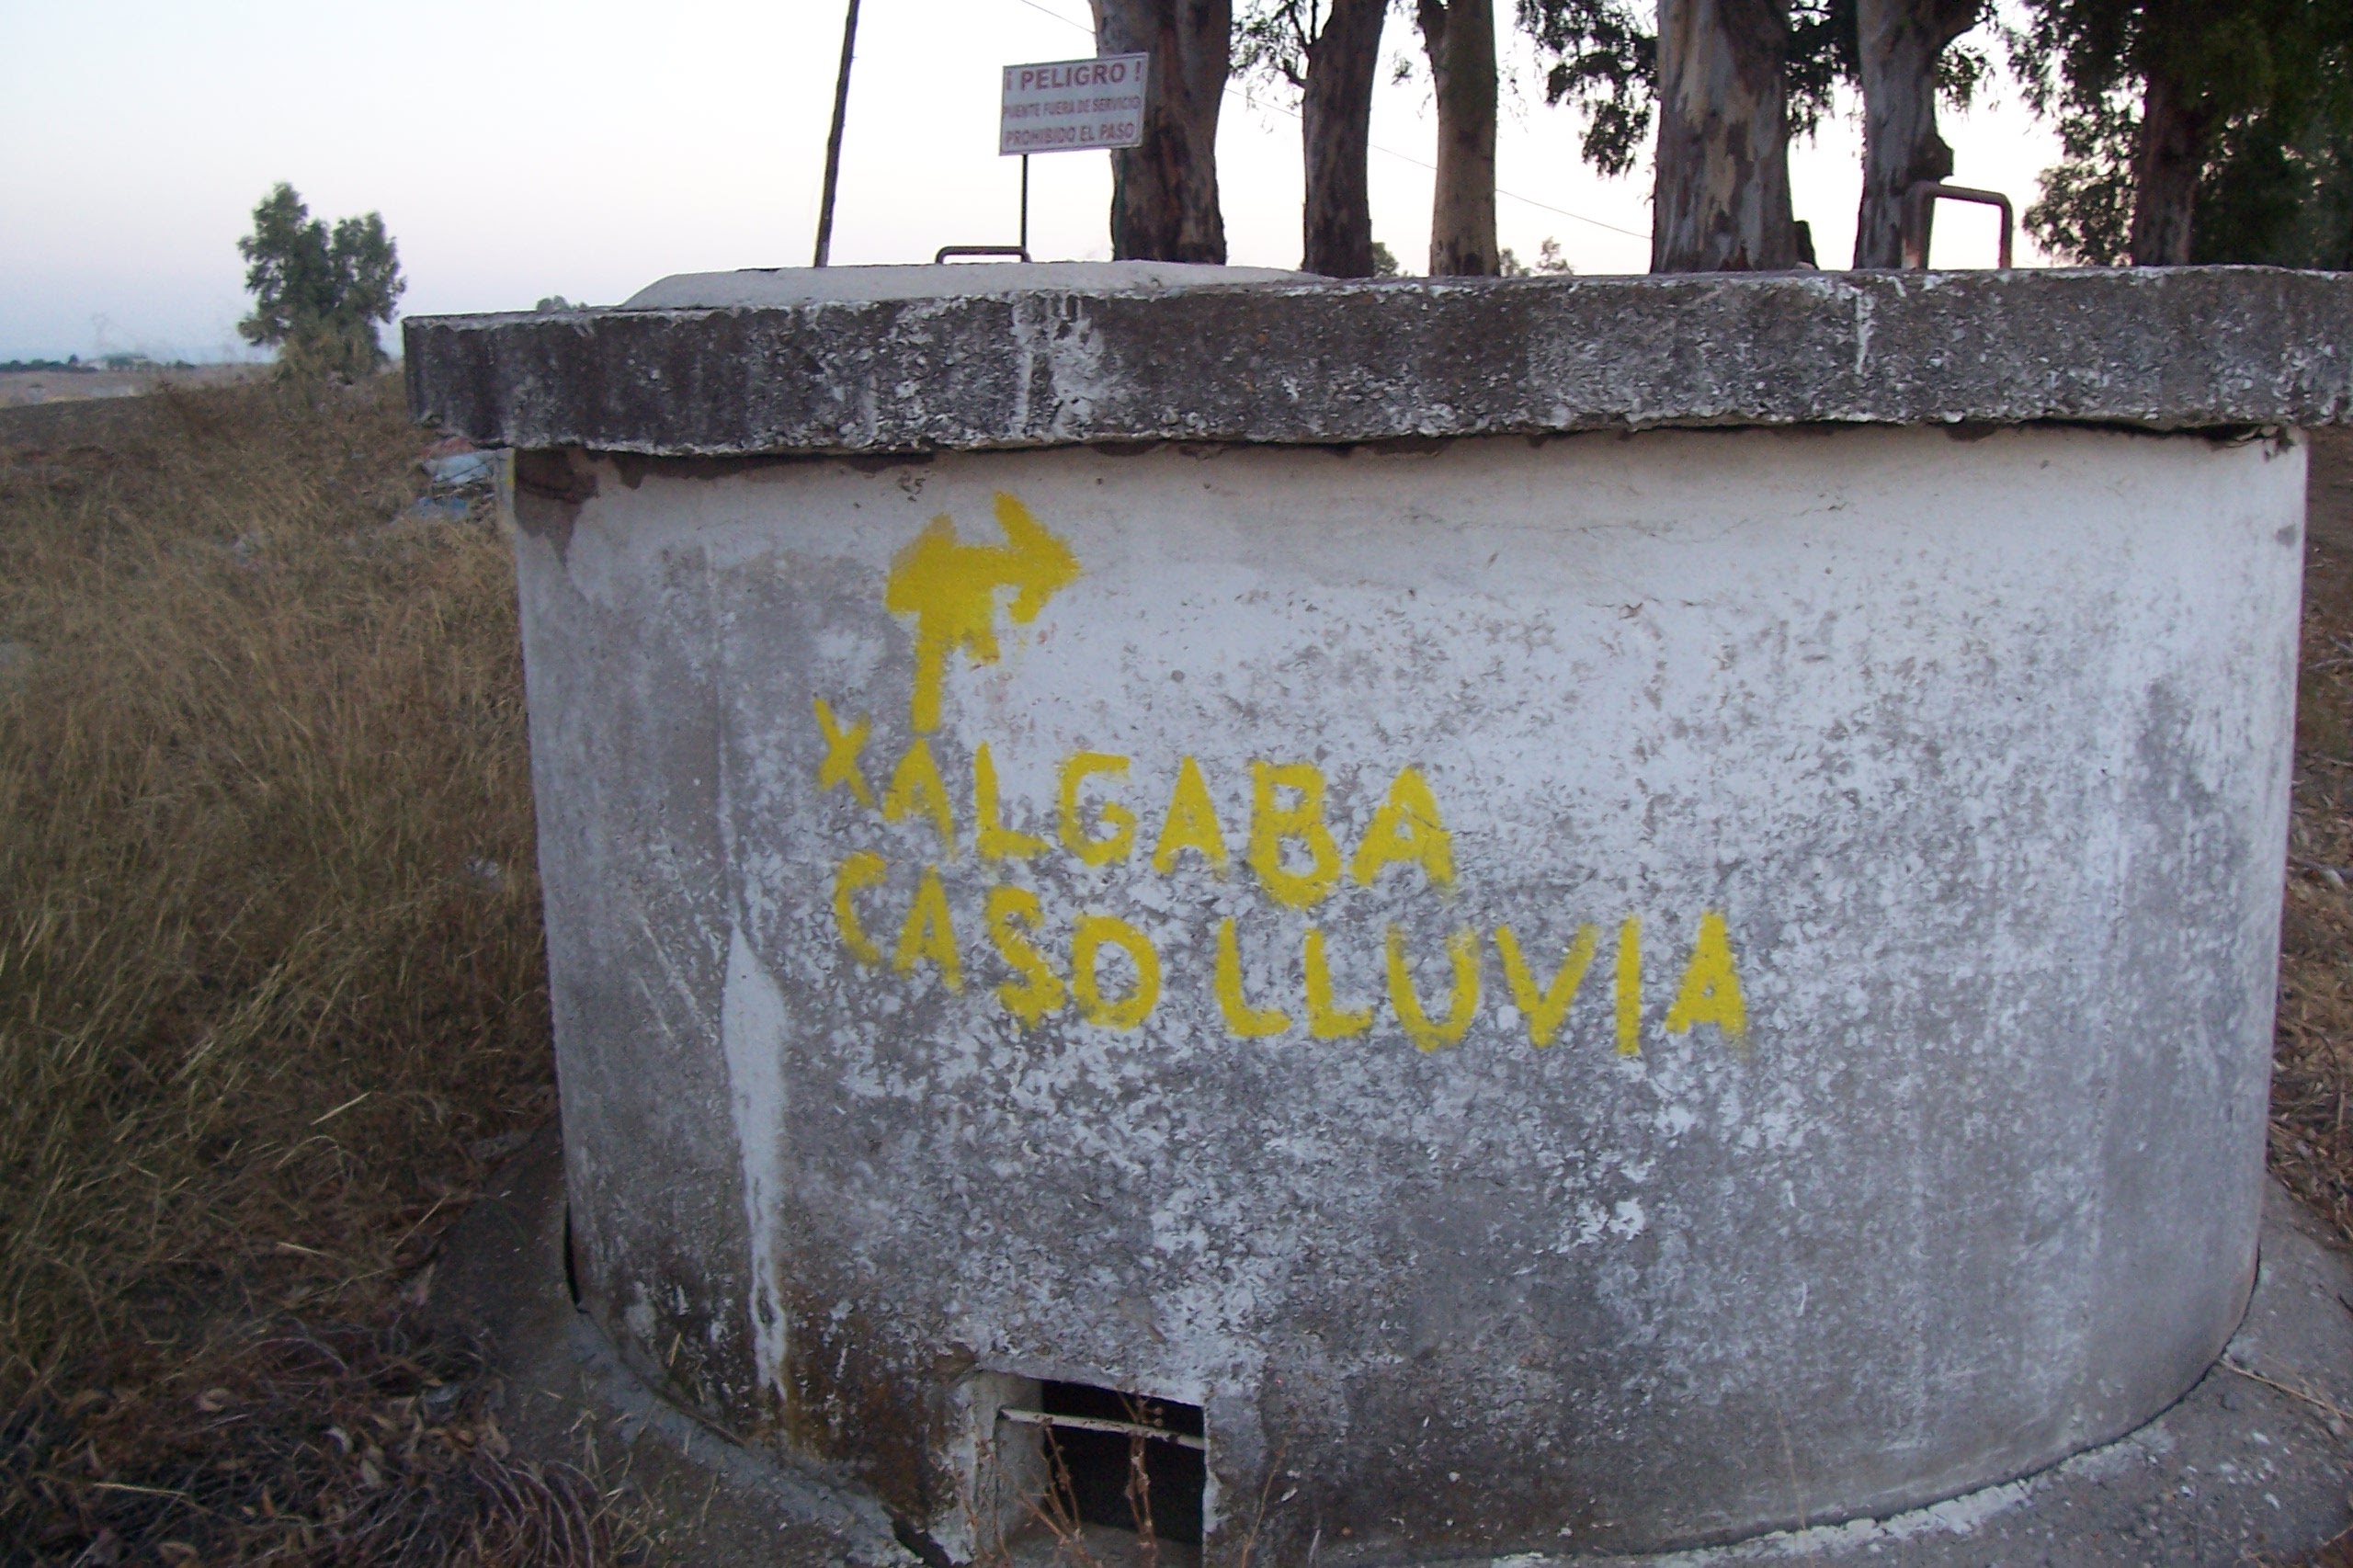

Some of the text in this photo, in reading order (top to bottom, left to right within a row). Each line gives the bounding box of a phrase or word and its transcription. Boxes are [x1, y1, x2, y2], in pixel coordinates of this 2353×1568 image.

[1077, 97, 1090, 114] DE
[1006, 121, 1134, 146] PROHIBIDO EL PASO
[833, 851, 1749, 1057] CASO LLUVIA
